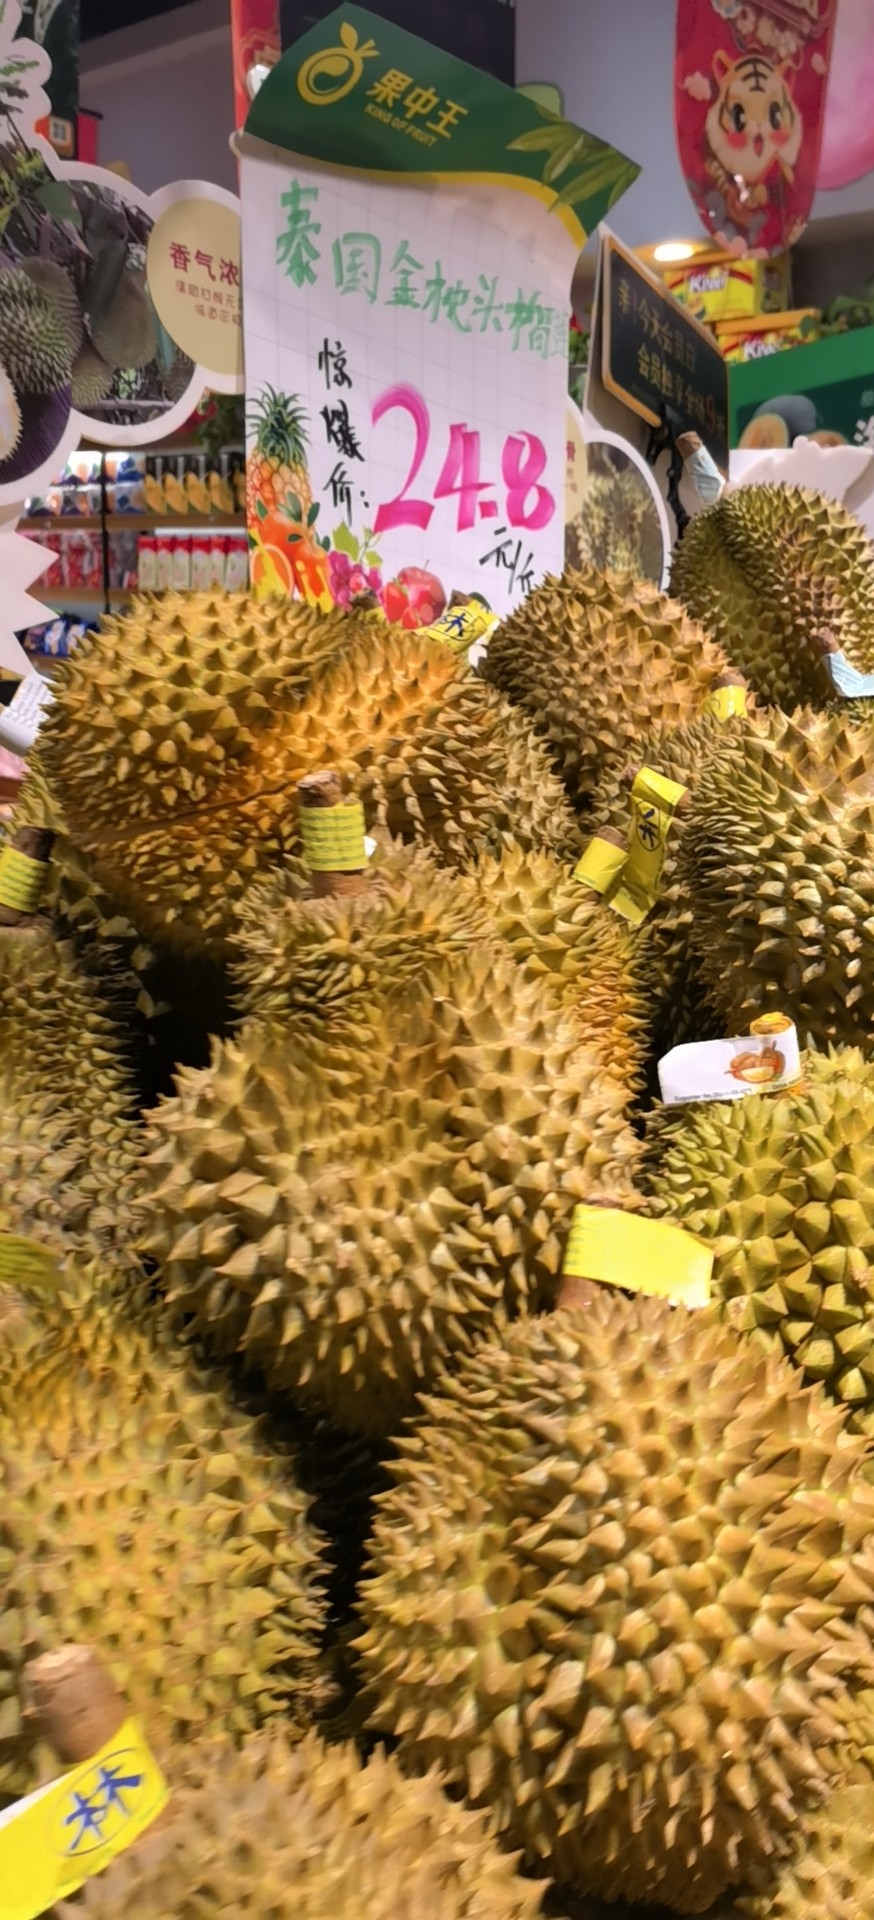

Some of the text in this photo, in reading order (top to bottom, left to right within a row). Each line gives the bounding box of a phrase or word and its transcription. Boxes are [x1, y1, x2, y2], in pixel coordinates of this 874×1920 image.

[364, 103, 438, 147] KING OF FRUIT
[365, 68, 469, 138] 果中王
[169, 241, 240, 287] 香气浓
[371, 381, 556, 532] 24.8
